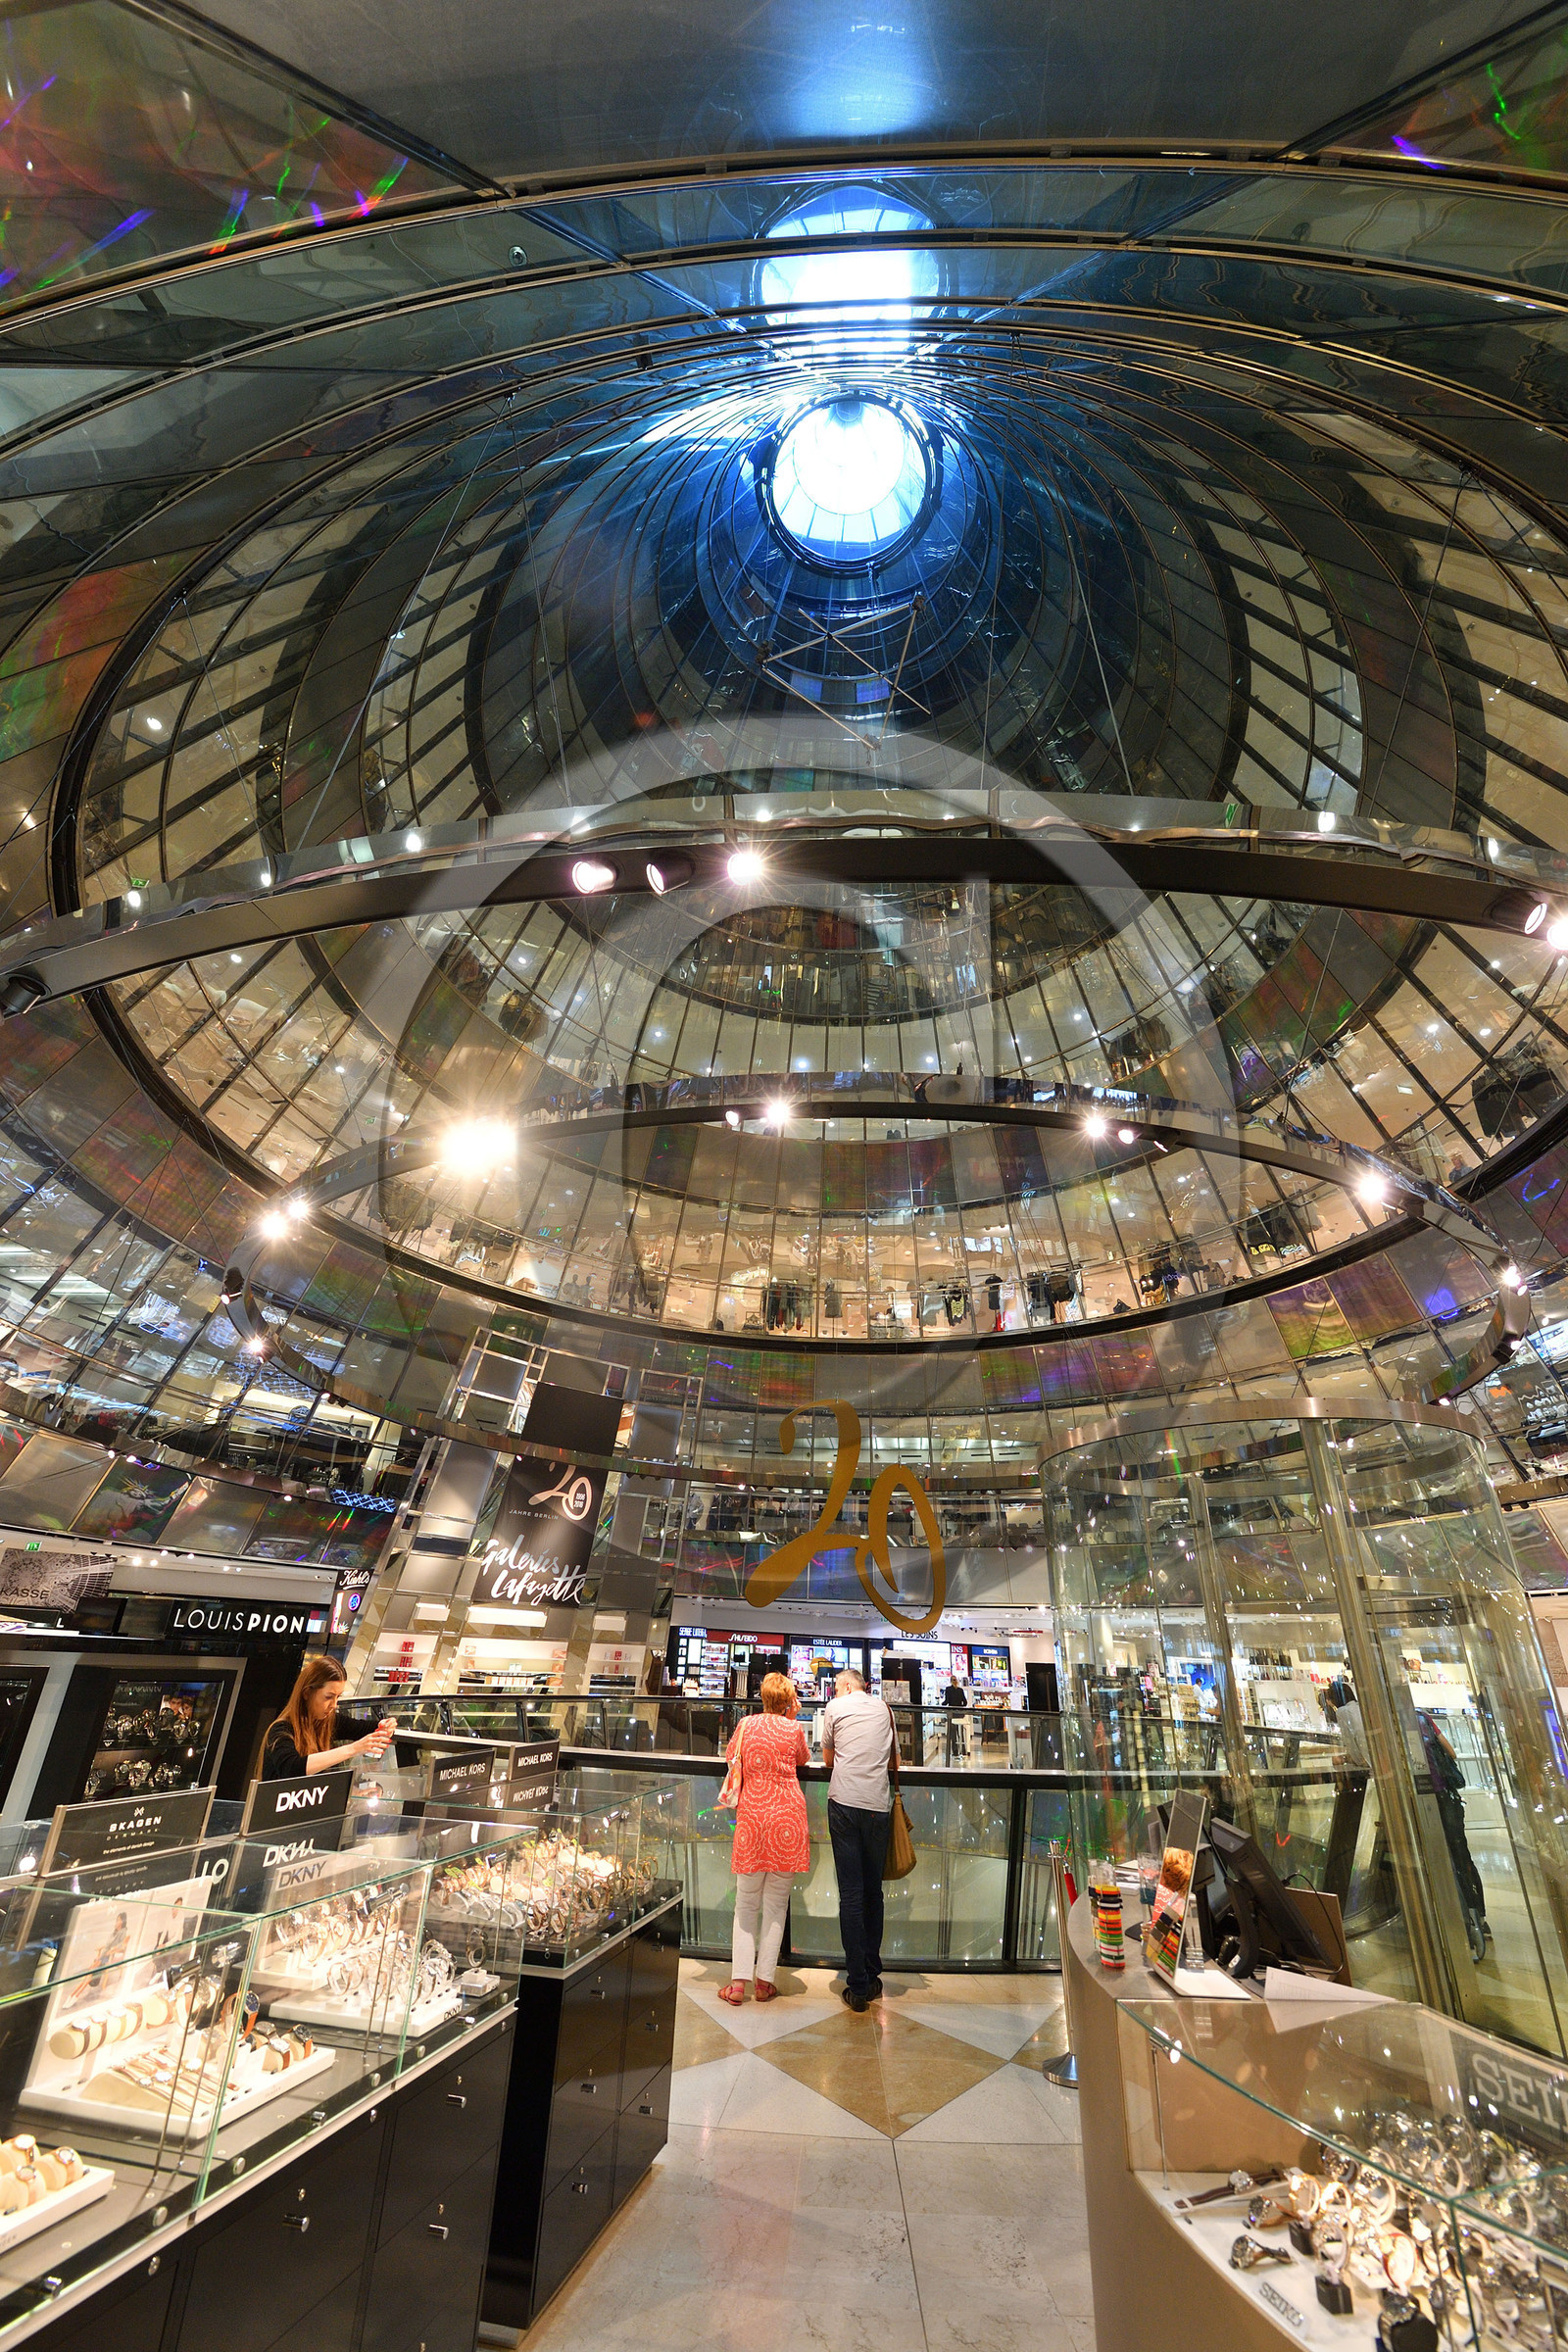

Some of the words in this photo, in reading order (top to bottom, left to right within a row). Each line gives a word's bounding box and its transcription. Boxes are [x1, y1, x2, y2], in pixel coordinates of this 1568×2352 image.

[745, 1398, 947, 1635] 20
[481, 1534, 560, 1576] Galeries
[339, 1569, 370, 1586] Kiehl's
[491, 1565, 587, 1606] Lafayette
[0, 1587, 50, 1599] KASSE
[728, 1633, 758, 1642] SHISEIDO
[517, 1754, 539, 1767] MICHAEL
[539, 1752, 553, 1763] KORS
[439, 1766, 467, 1781] MICHAEL
[468, 1762, 486, 1775] KORS
[275, 1786, 329, 1812] DKNY
[109, 1816, 163, 1832] SKAGEN
[278, 1861, 326, 1888] DKNY
